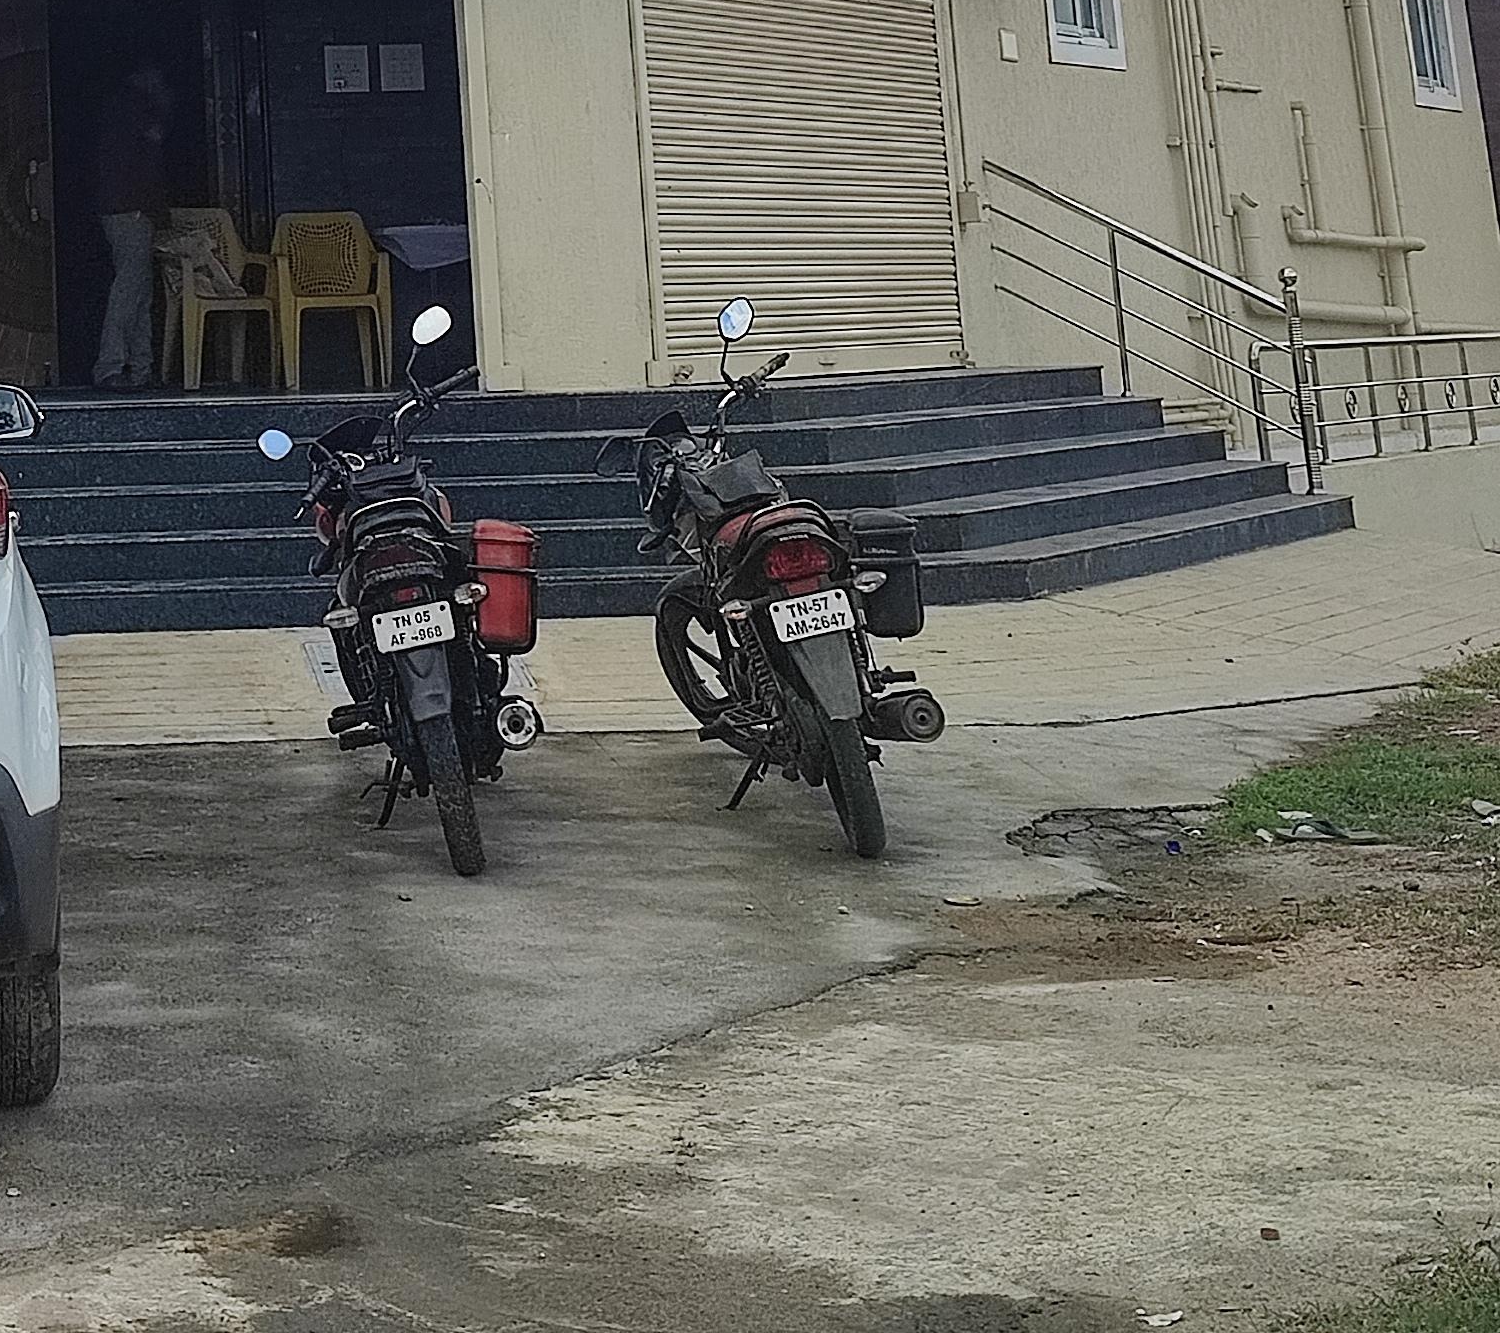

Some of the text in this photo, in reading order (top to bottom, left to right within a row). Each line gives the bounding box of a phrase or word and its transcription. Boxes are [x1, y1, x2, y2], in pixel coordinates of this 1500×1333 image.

[785, 596, 829, 618] TN-57
[392, 610, 431, 629] TN 05
[786, 612, 846, 638] AM-2647
[391, 633, 406, 646] AF
